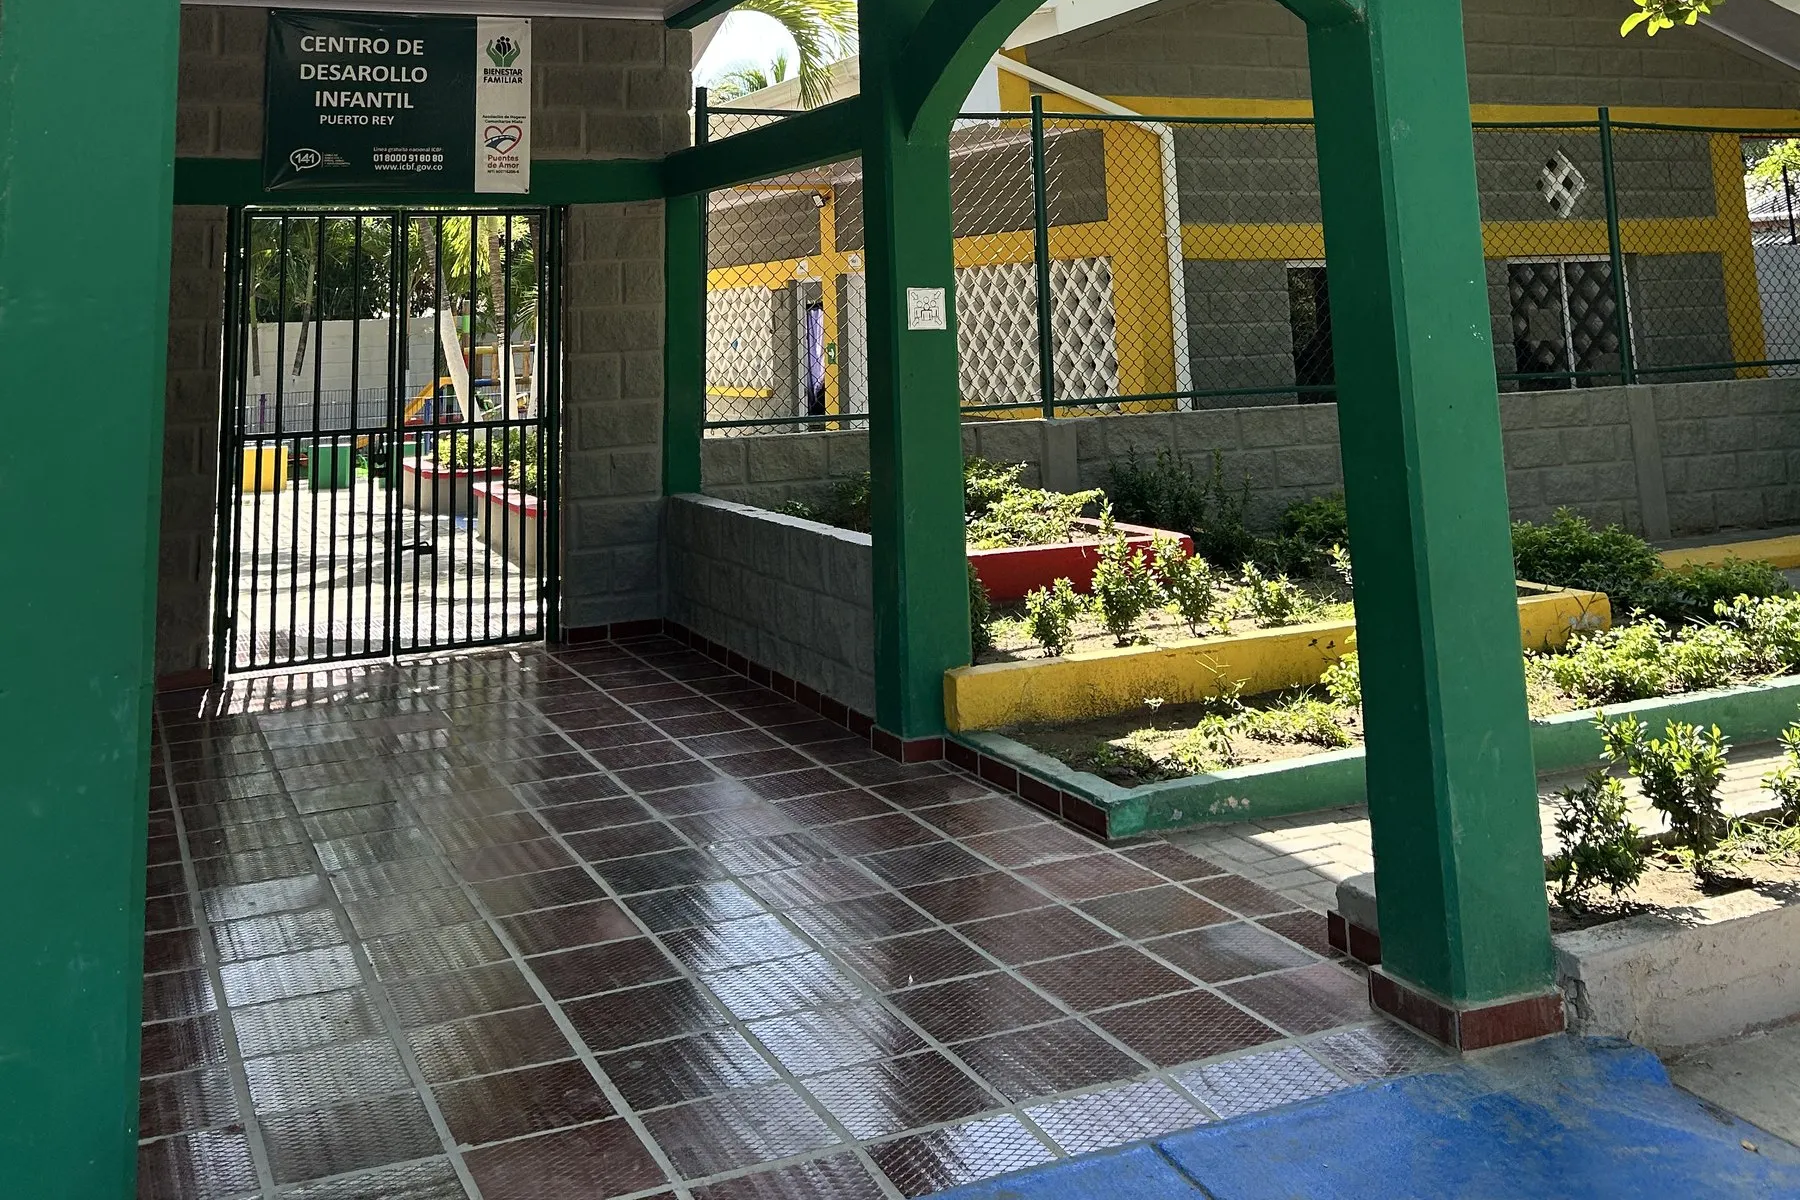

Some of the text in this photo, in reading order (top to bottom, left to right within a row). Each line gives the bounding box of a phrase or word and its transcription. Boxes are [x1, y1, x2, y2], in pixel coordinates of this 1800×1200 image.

[300, 36, 424, 55] CENTRO DE
[300, 63, 428, 83] DESAROLLO
[483, 68, 523, 76] BIENESTAR
[483, 76, 523, 84] FAMILIAR
[315, 91, 414, 109] INFANTIL
[319, 115, 395, 125] PUERTO REY
[295, 153, 315, 164] 141
[374, 163, 443, 172] www.icbf.gov.co
